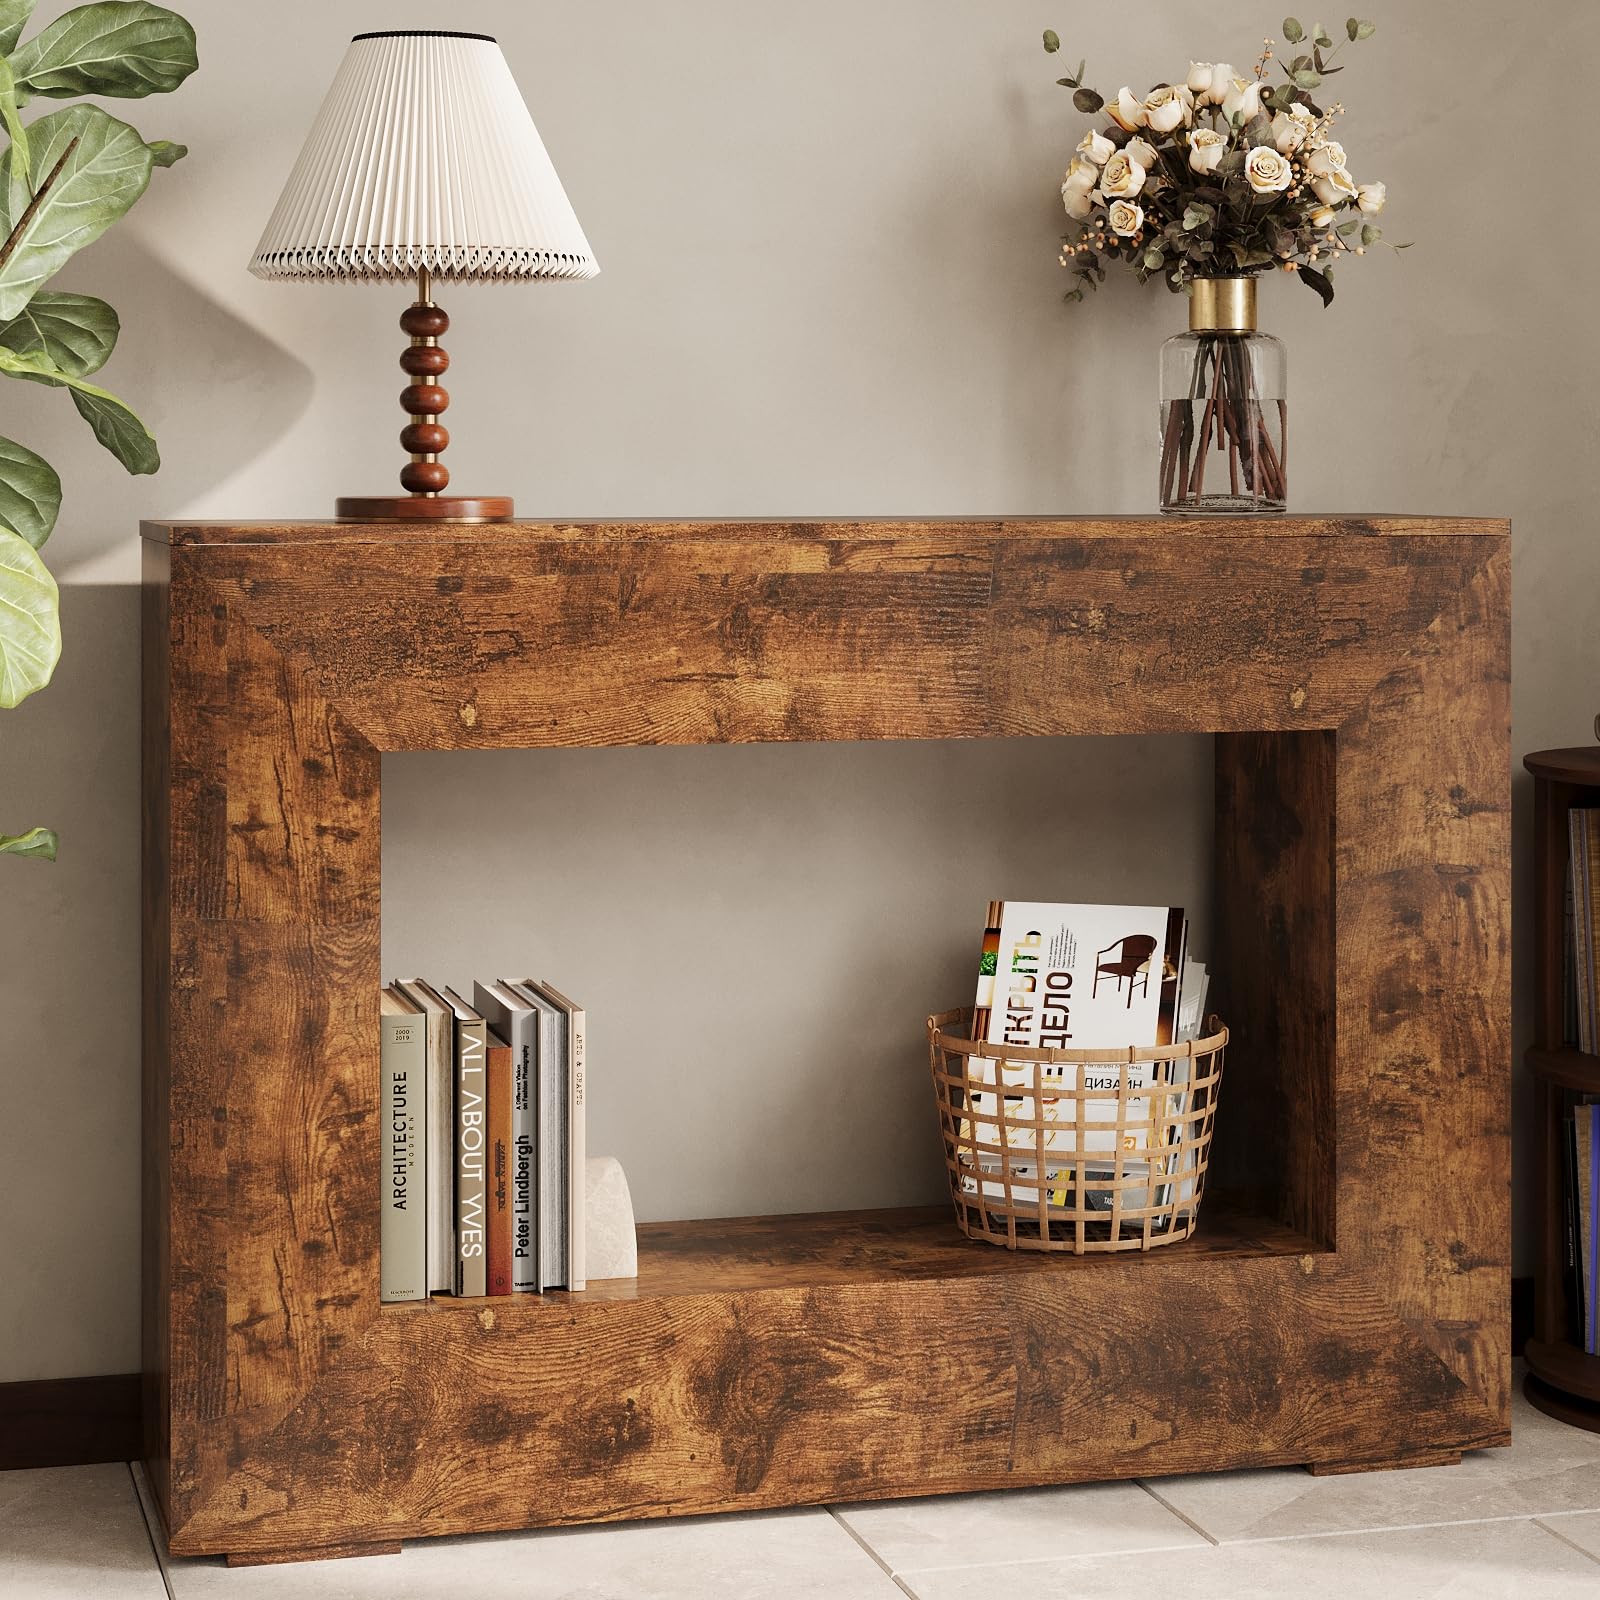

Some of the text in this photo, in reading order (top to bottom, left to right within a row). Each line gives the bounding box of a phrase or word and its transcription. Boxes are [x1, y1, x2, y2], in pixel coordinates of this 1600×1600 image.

[1038, 971, 1073, 1050] ДЕЛО
[393, 1072, 407, 1210] ARCHITECTURE
[461, 1033, 482, 1257] ALL ABOUT YVES
[515, 1135, 533, 1257] Peter Lindbergh
